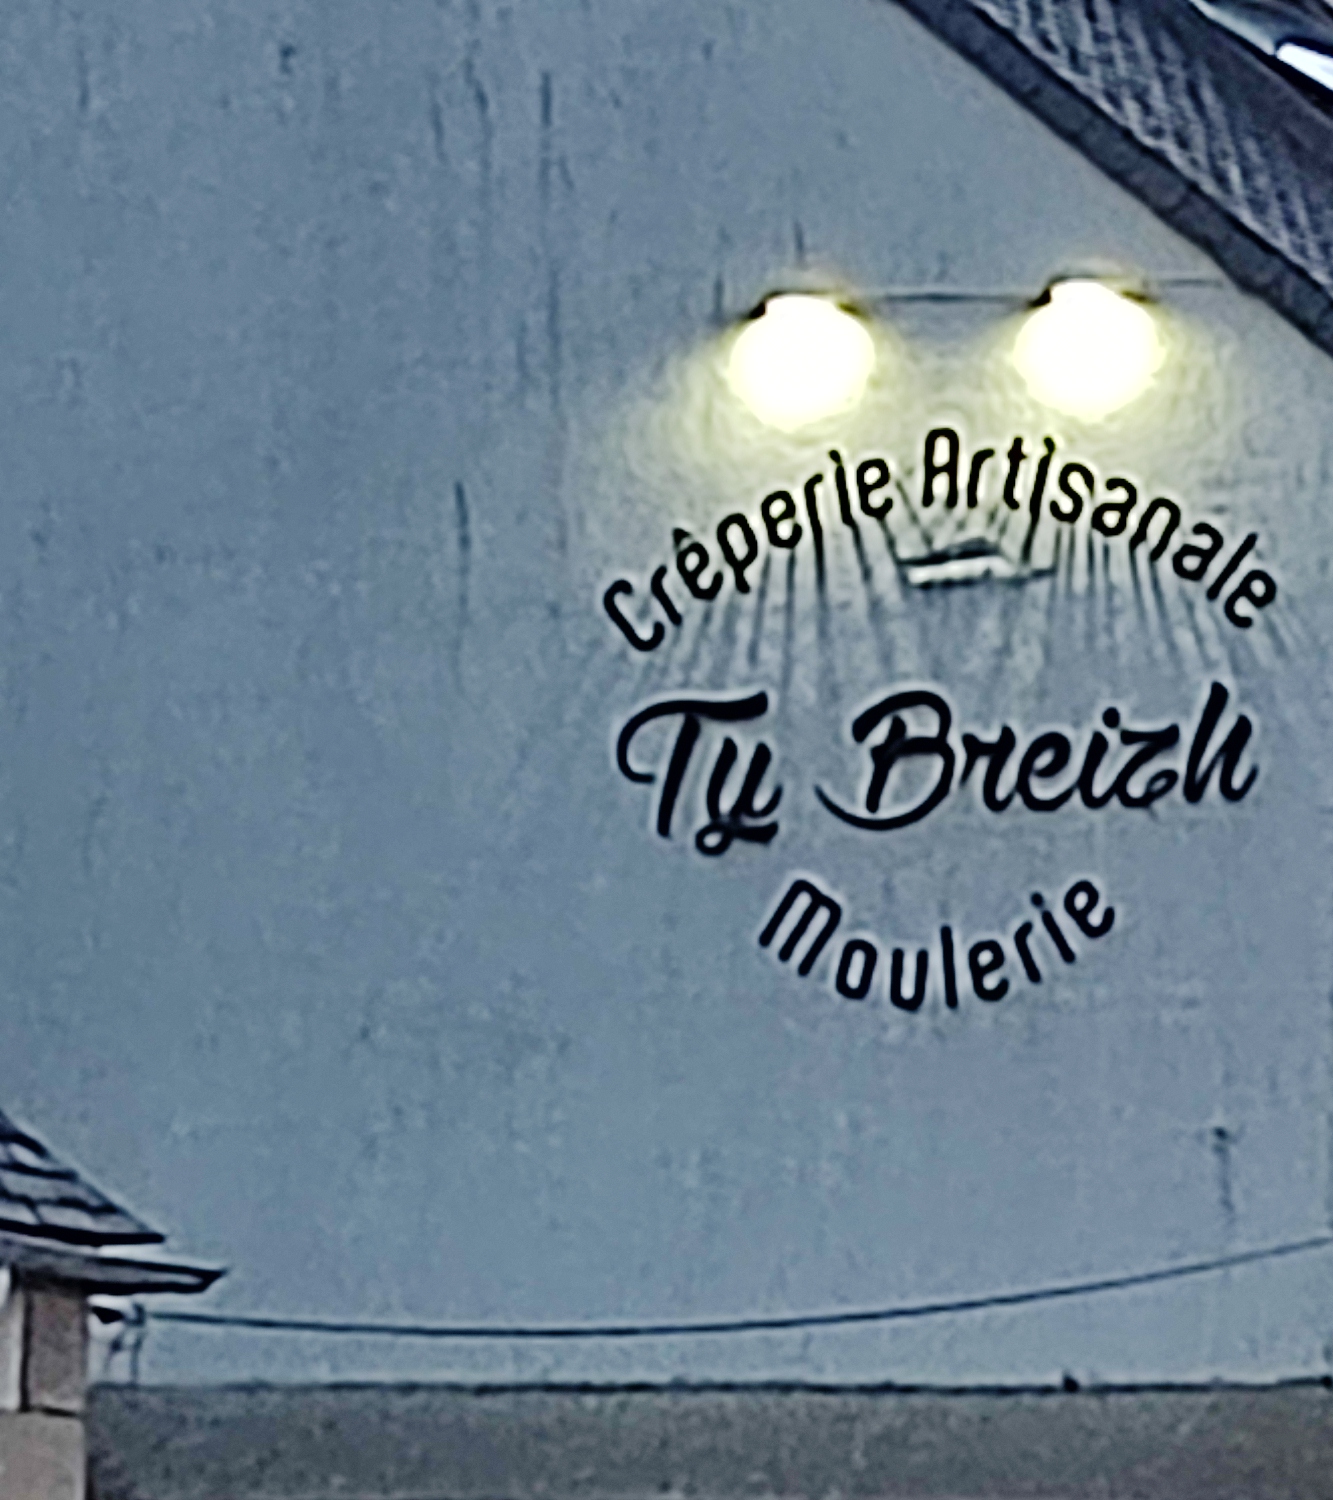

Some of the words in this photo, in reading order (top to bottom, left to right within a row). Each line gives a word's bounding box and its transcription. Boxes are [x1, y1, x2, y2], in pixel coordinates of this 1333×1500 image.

[921, 427, 1277, 628] Artisanale
[616, 690, 783, 856] Ty
[814, 681, 1258, 831] Breizh
[758, 879, 1115, 1011] Moulerie
